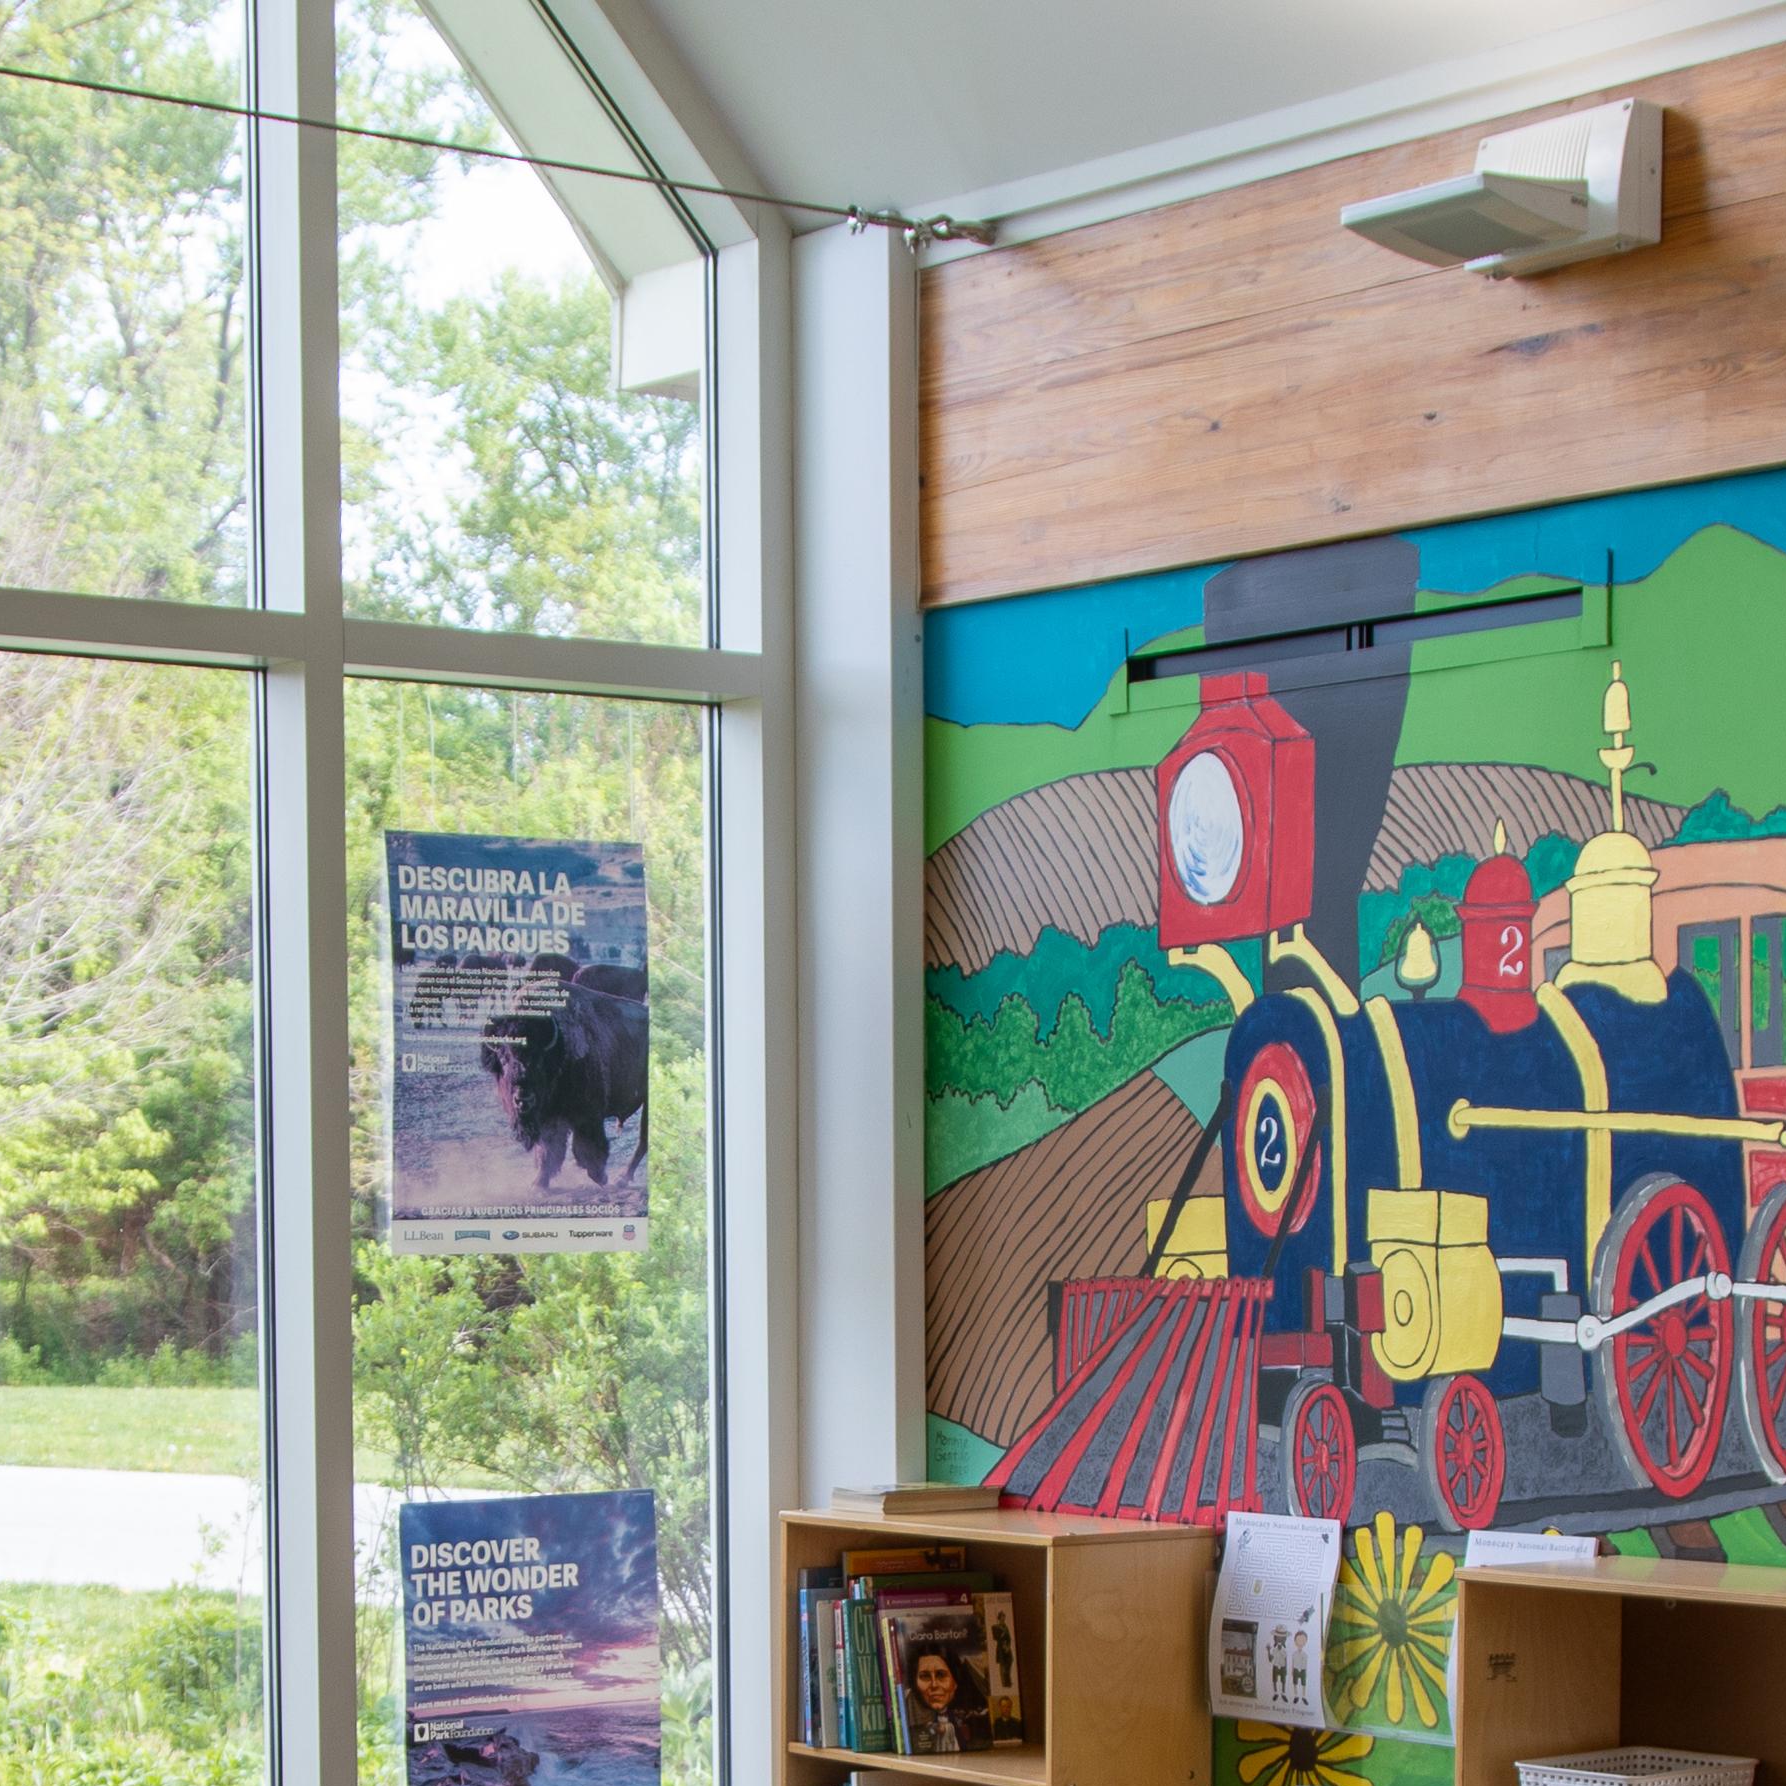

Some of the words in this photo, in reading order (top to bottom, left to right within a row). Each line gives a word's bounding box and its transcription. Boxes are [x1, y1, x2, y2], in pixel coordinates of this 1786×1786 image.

[398, 865, 535, 895] DESCUBRA
[539, 871, 571, 896] LA
[399, 894, 548, 924] MARAVILLA
[553, 900, 586, 926] DE
[402, 924, 448, 950] LOS
[453, 926, 571, 953] PARQUES
[1499, 925, 1524, 976] 2
[1260, 1117, 1282, 1167] 2
[422, 1205, 464, 1216] GRACIAS
[474, 1205, 523, 1216] NUESTROS
[524, 1205, 584, 1215] PRINCIPALES
[586, 1205, 621, 1214] SOCIOS
[569, 1229, 613, 1238] Tupperware
[411, 1537, 540, 1569] DISCOVER
[411, 1571, 461, 1597] THE
[465, 1563, 579, 1594] WONDER
[413, 1601, 445, 1626] OF
[450, 1594, 533, 1624] PARKS
[430, 1719, 463, 1731] National
[862, 1704, 886, 1731] KID
